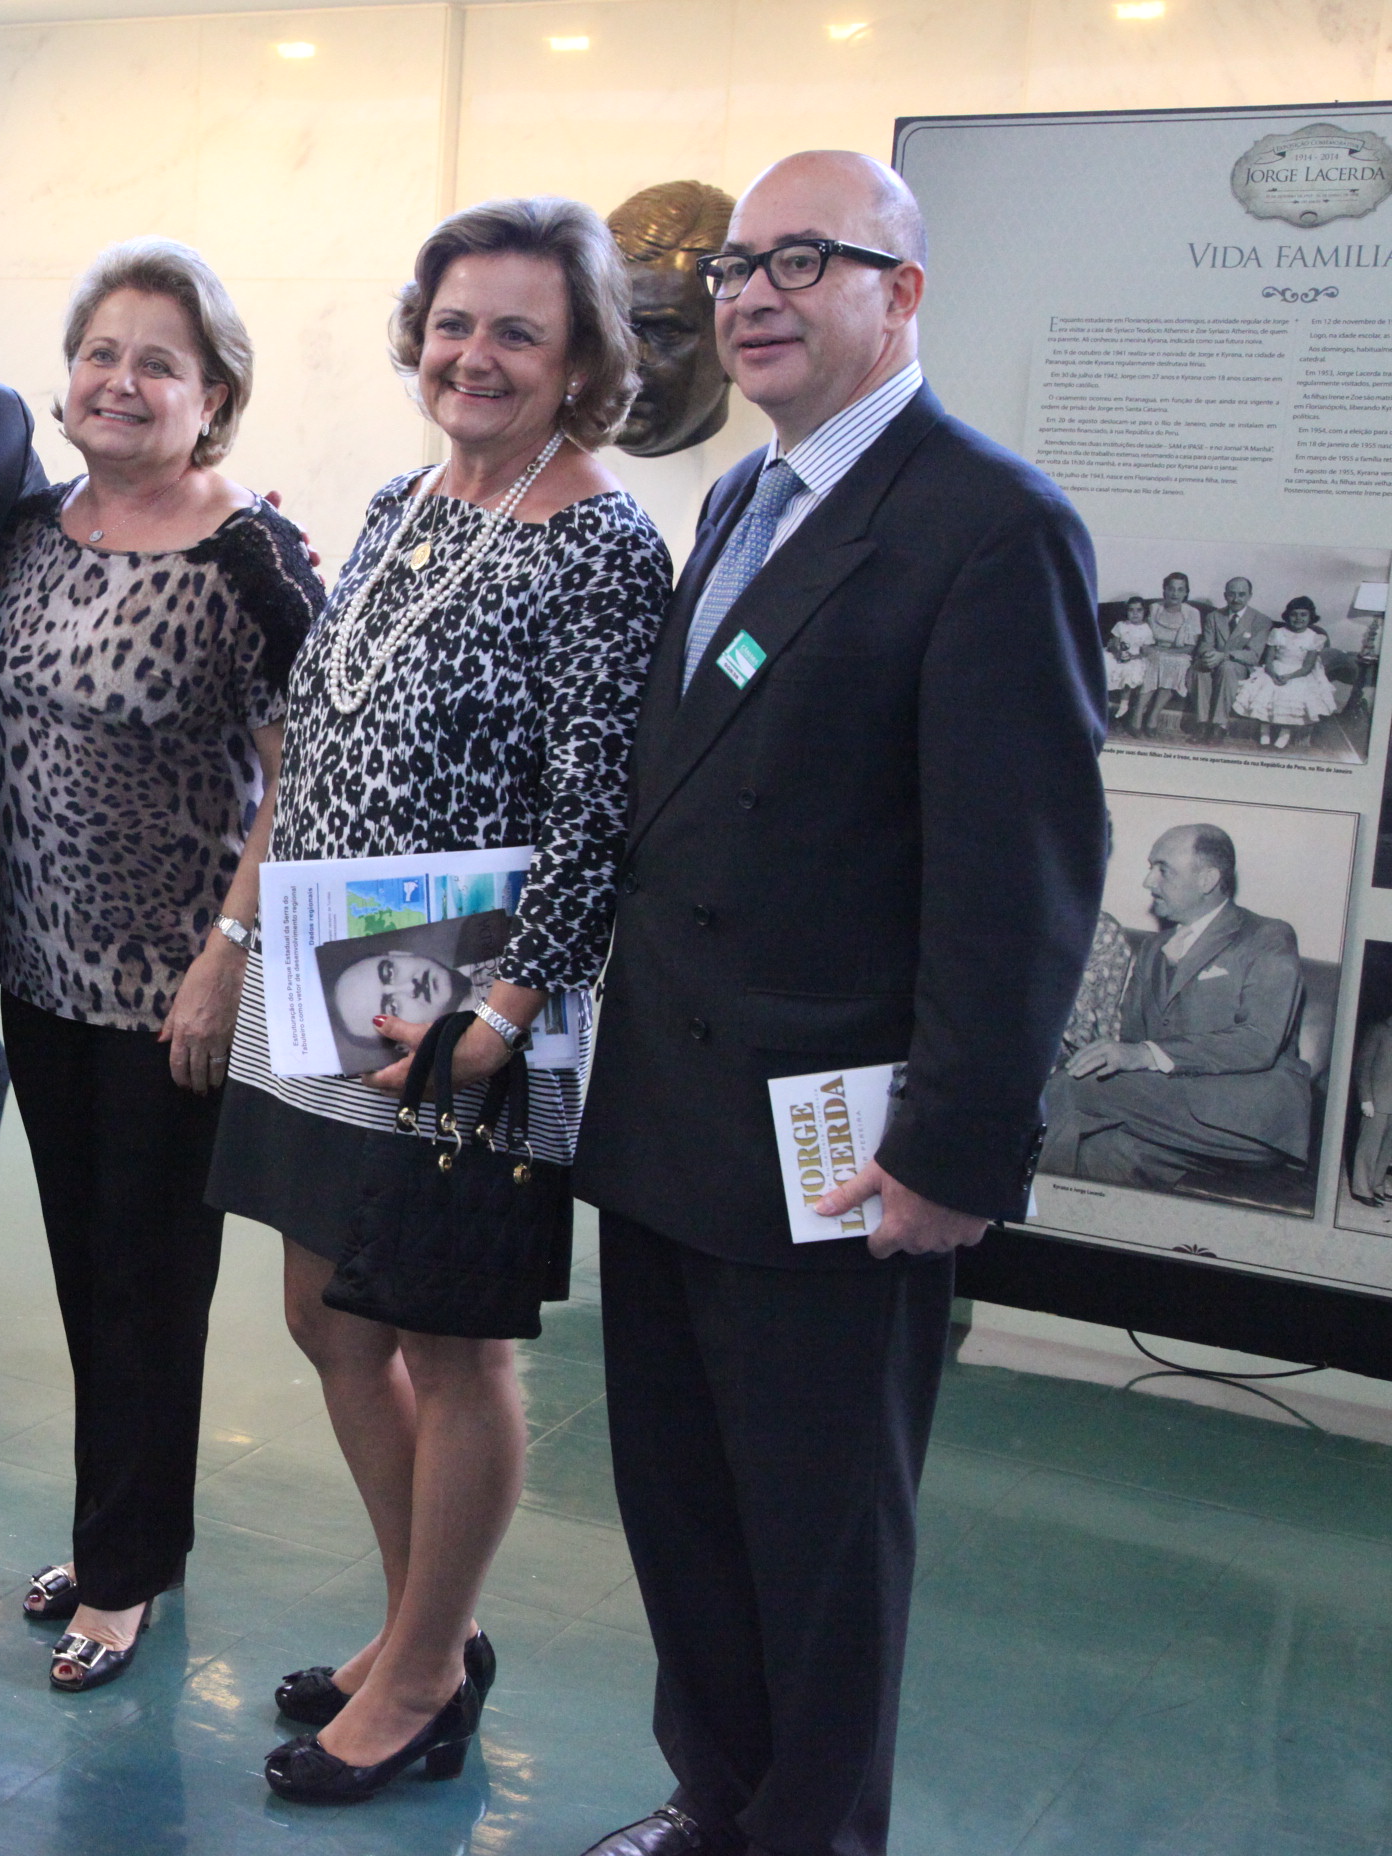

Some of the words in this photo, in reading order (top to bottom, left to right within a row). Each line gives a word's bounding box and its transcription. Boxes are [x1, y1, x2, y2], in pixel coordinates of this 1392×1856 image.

[1245, 168, 1298, 186] JORGE
[1305, 166, 1385, 182] LACERDA
[1188, 242, 1262, 268] VIDA
[283, 896, 289, 904] do
[291, 886, 299, 913] regional
[285, 925, 290, 934] da
[287, 966, 295, 990] Parque
[295, 973, 300, 981] de
[289, 992, 294, 1001] do
[290, 1004, 298, 1046] Estruturação
[299, 1025, 307, 1055] Tabuleiro
[790, 1102, 825, 1207] JORGE
[820, 1075, 866, 1232] LCERDA
